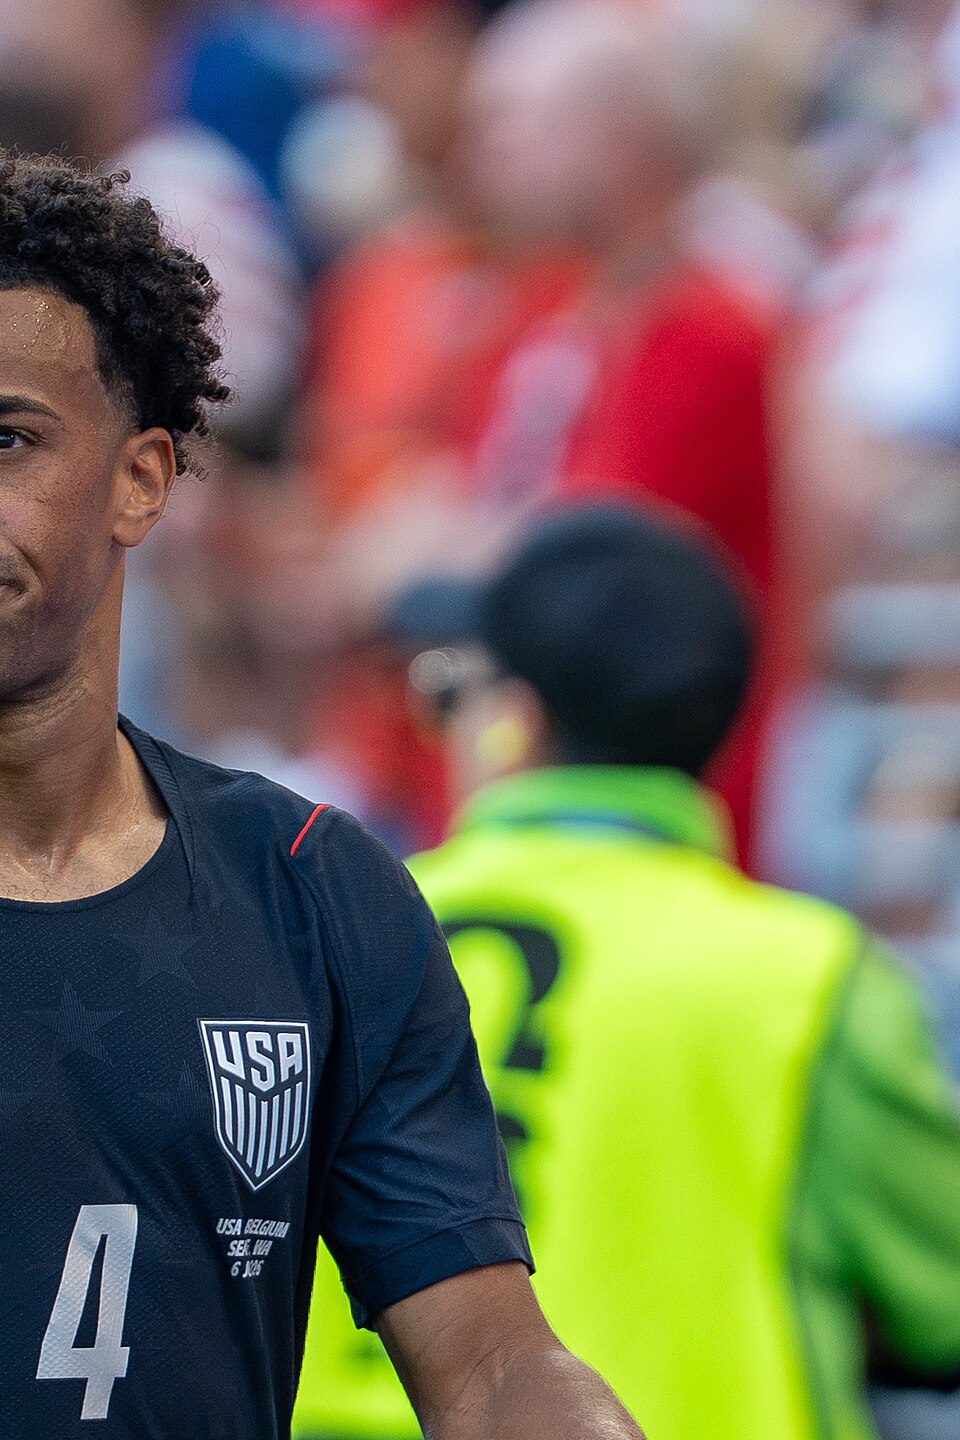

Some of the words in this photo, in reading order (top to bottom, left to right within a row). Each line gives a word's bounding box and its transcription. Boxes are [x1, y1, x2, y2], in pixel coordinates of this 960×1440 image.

[212, 1031, 303, 1092] USA
[216, 1218, 242, 1235] USA
[244, 1218, 291, 1238] BELGIUM
[230, 1260, 242, 1277] 6
[36, 1204, 138, 1420] 4
